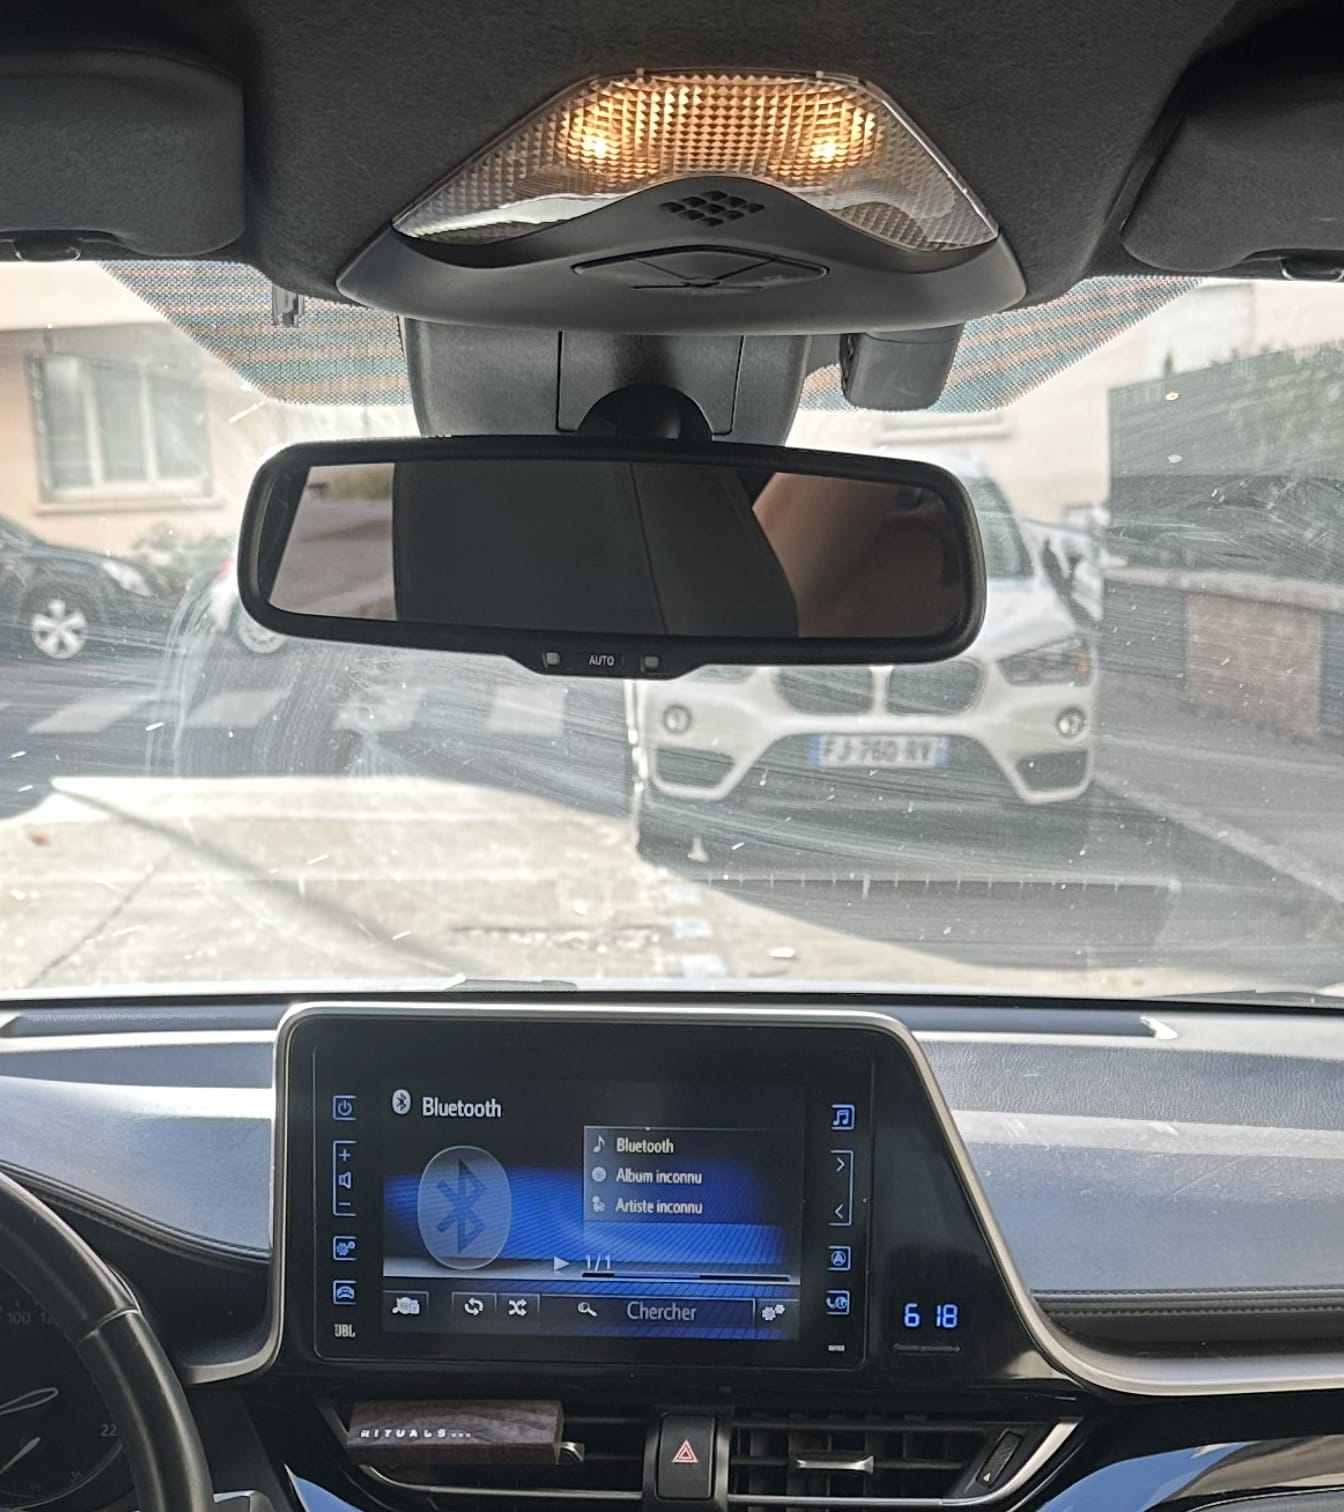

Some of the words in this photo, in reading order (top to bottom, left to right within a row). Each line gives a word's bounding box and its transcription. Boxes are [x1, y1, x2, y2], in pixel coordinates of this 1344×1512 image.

[588, 655, 615, 667] AUTO
[422, 1096, 502, 1118] Bluetooth
[616, 1137, 674, 1153] Bluetooth
[616, 1167, 653, 1183] Album
[655, 1169, 703, 1184] inconnu
[615, 1197, 654, 1213] Artiste
[656, 1200, 703, 1214] inconnu
[585, 1254, 611, 1272] 1/1
[7, 1312, 31, 1325] 100
[627, 1301, 697, 1320] Chercher
[333, 1323, 356, 1338] JBL
[100, 1423, 118, 1437] 22
